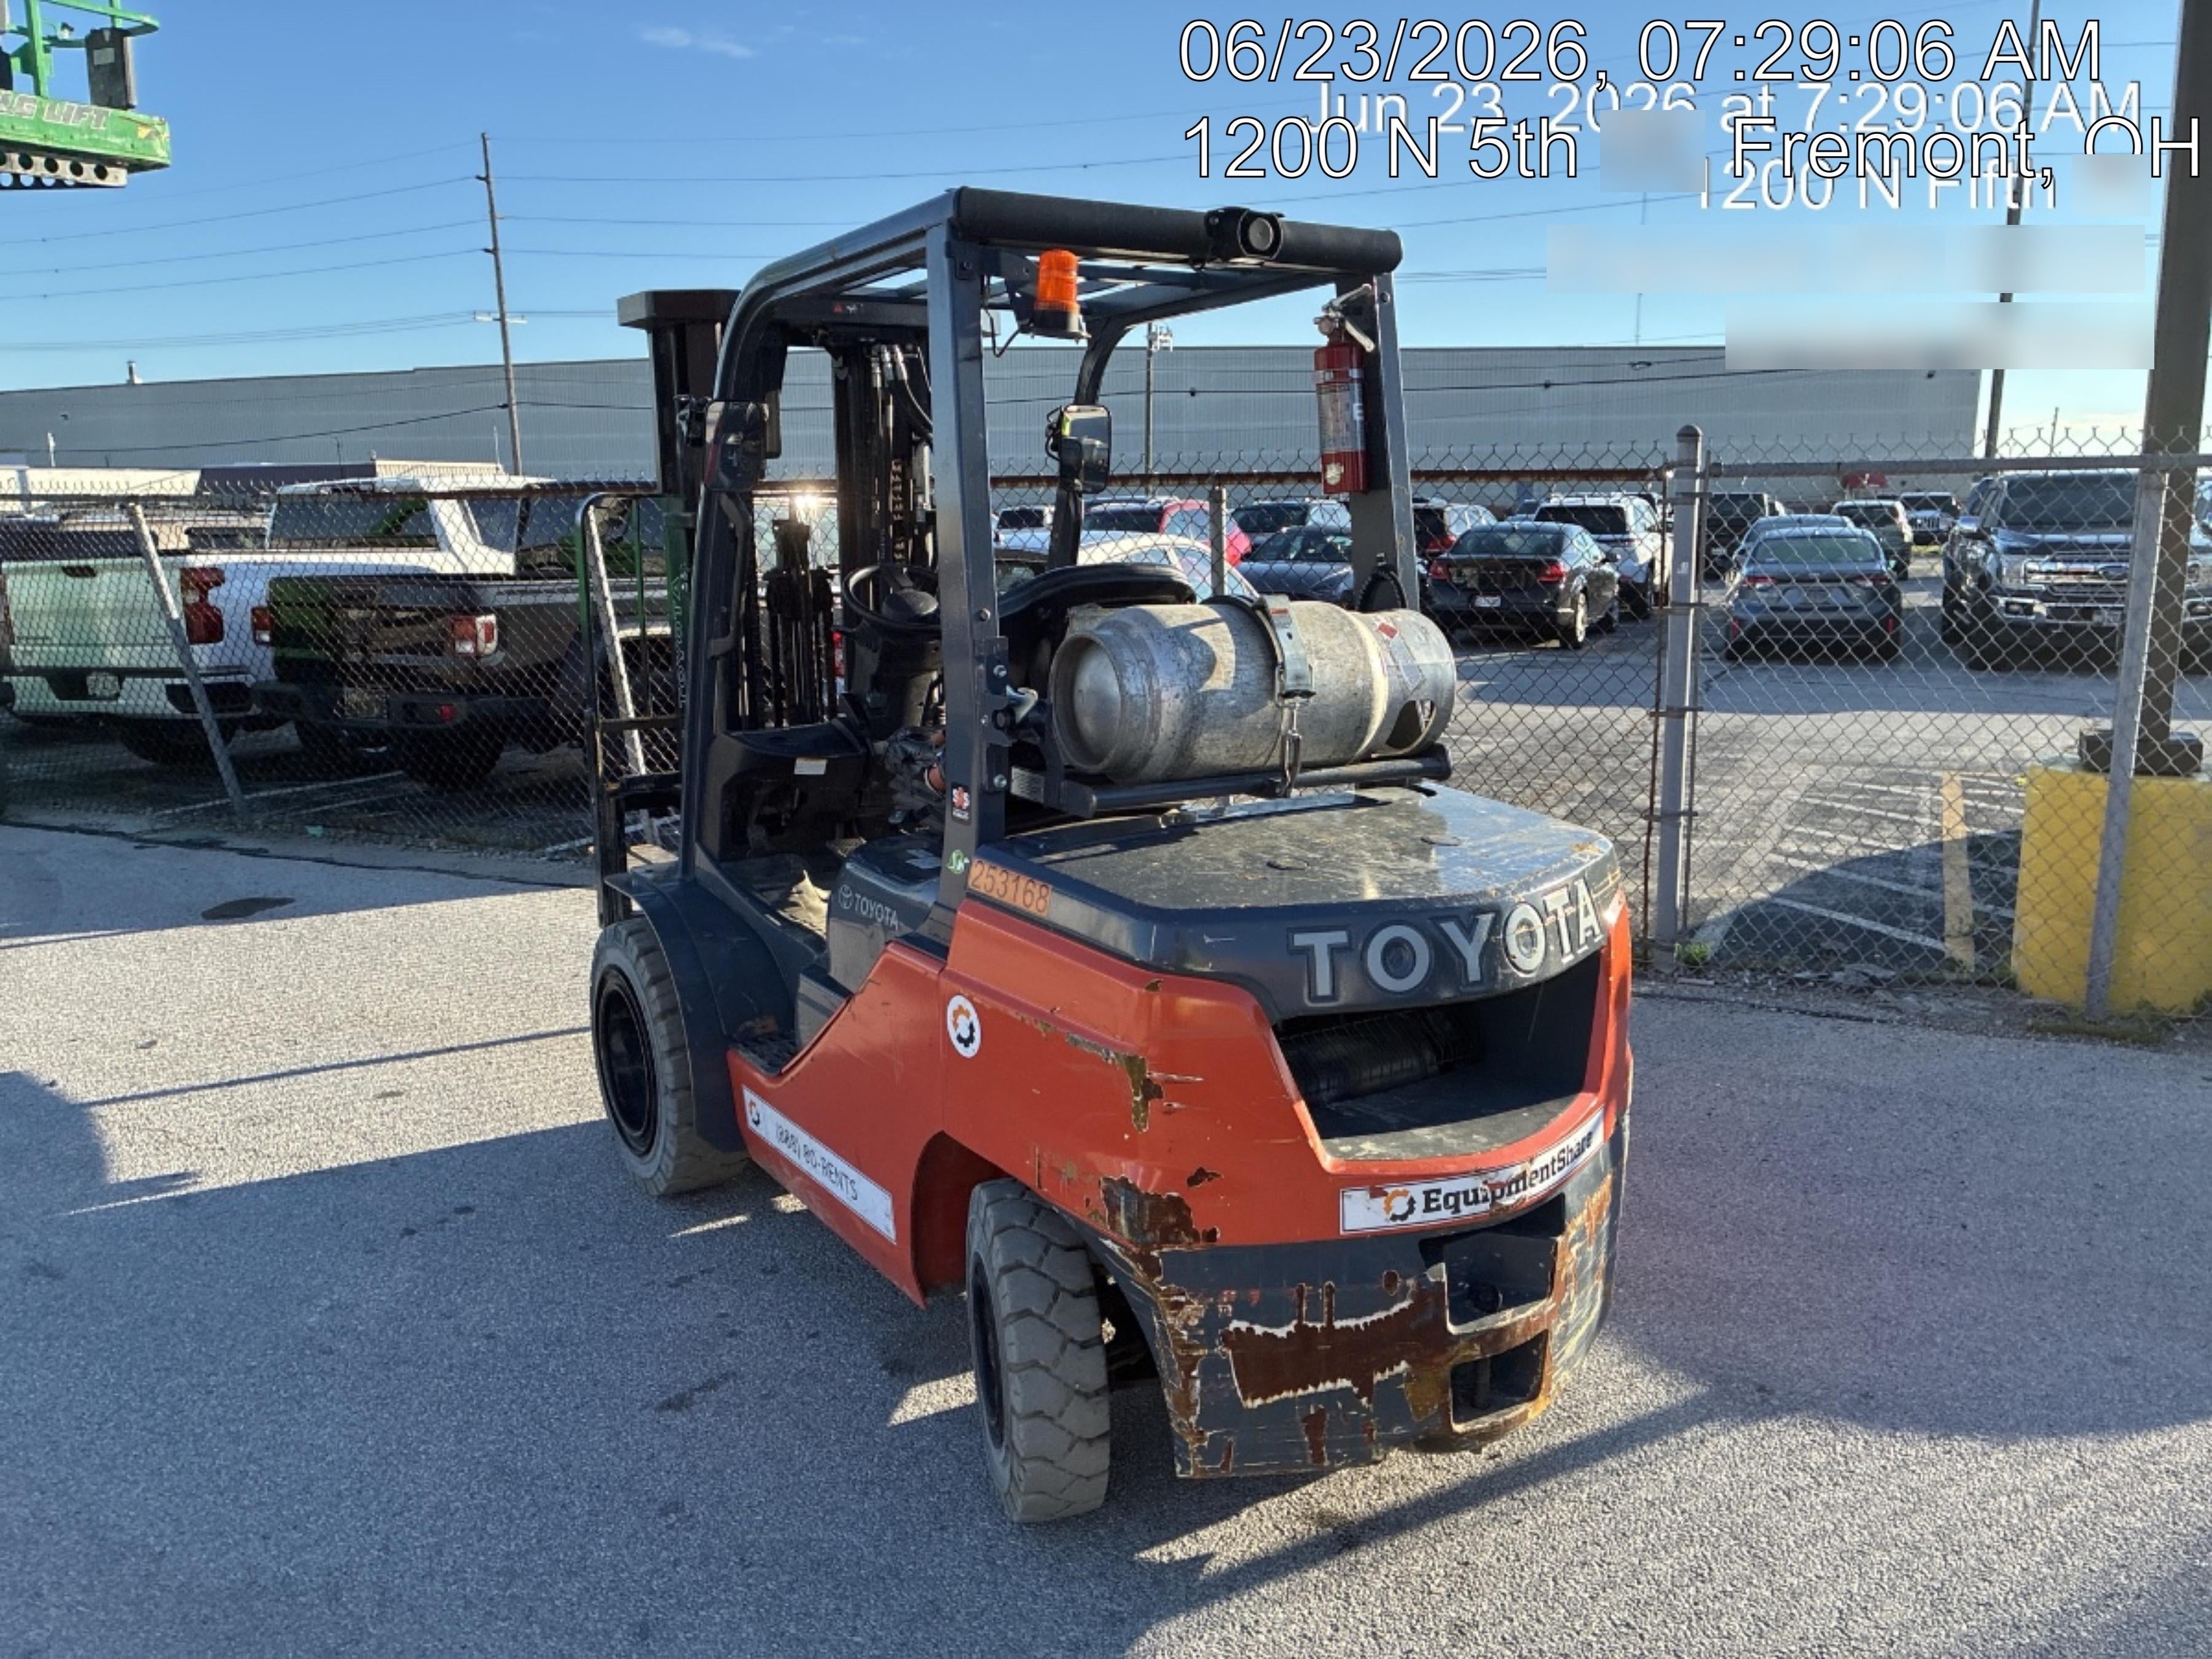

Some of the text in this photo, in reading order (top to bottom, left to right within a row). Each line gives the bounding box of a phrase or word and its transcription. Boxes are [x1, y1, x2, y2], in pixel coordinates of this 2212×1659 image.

[855, 893, 899, 931] TOYOTA
[970, 860, 1049, 913] 253168
[1290, 875, 1605, 1000] TOYOTA
[1422, 1131, 1594, 1216] EquipmentShare
